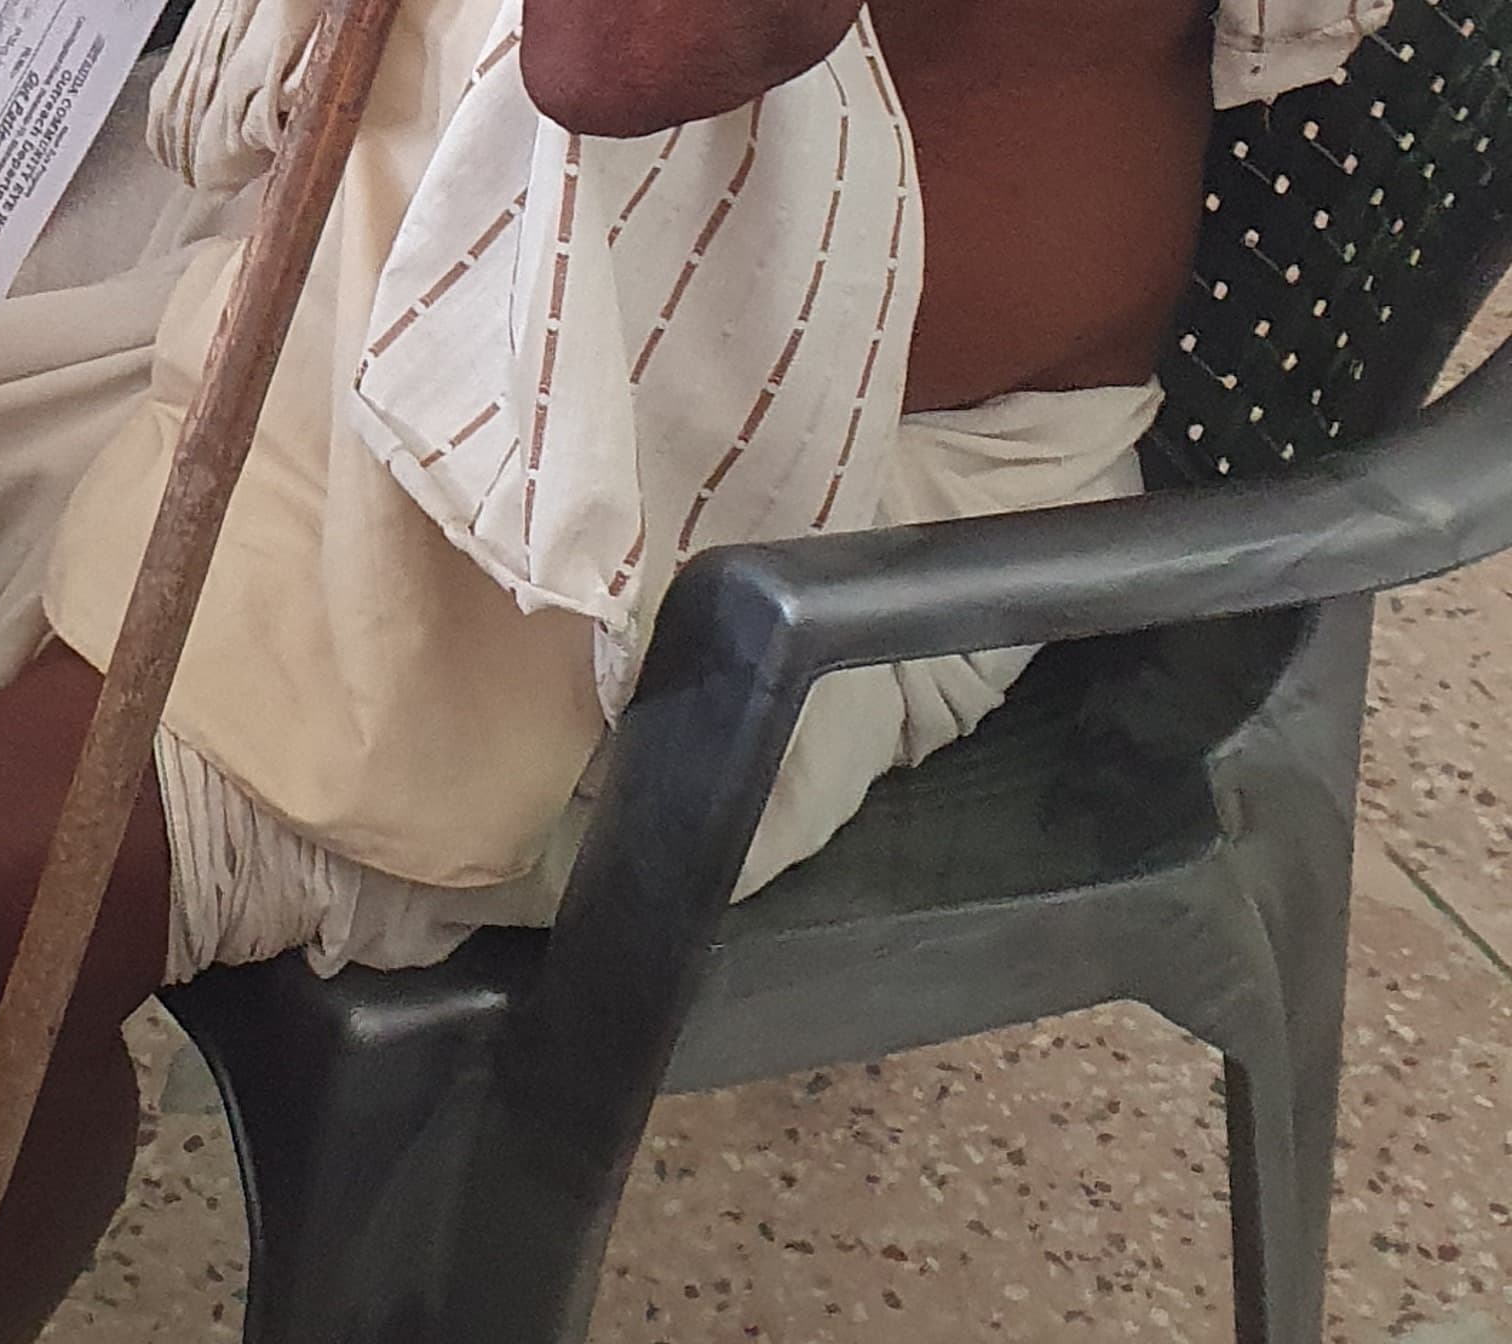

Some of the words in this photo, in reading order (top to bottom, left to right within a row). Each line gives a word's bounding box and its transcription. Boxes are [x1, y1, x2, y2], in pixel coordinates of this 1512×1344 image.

[15, 70, 41, 102] Out
[28, 69, 73, 138] Outreach
[16, 96, 72, 182] COMMUNITY
[0, 181, 24, 212] EYE
